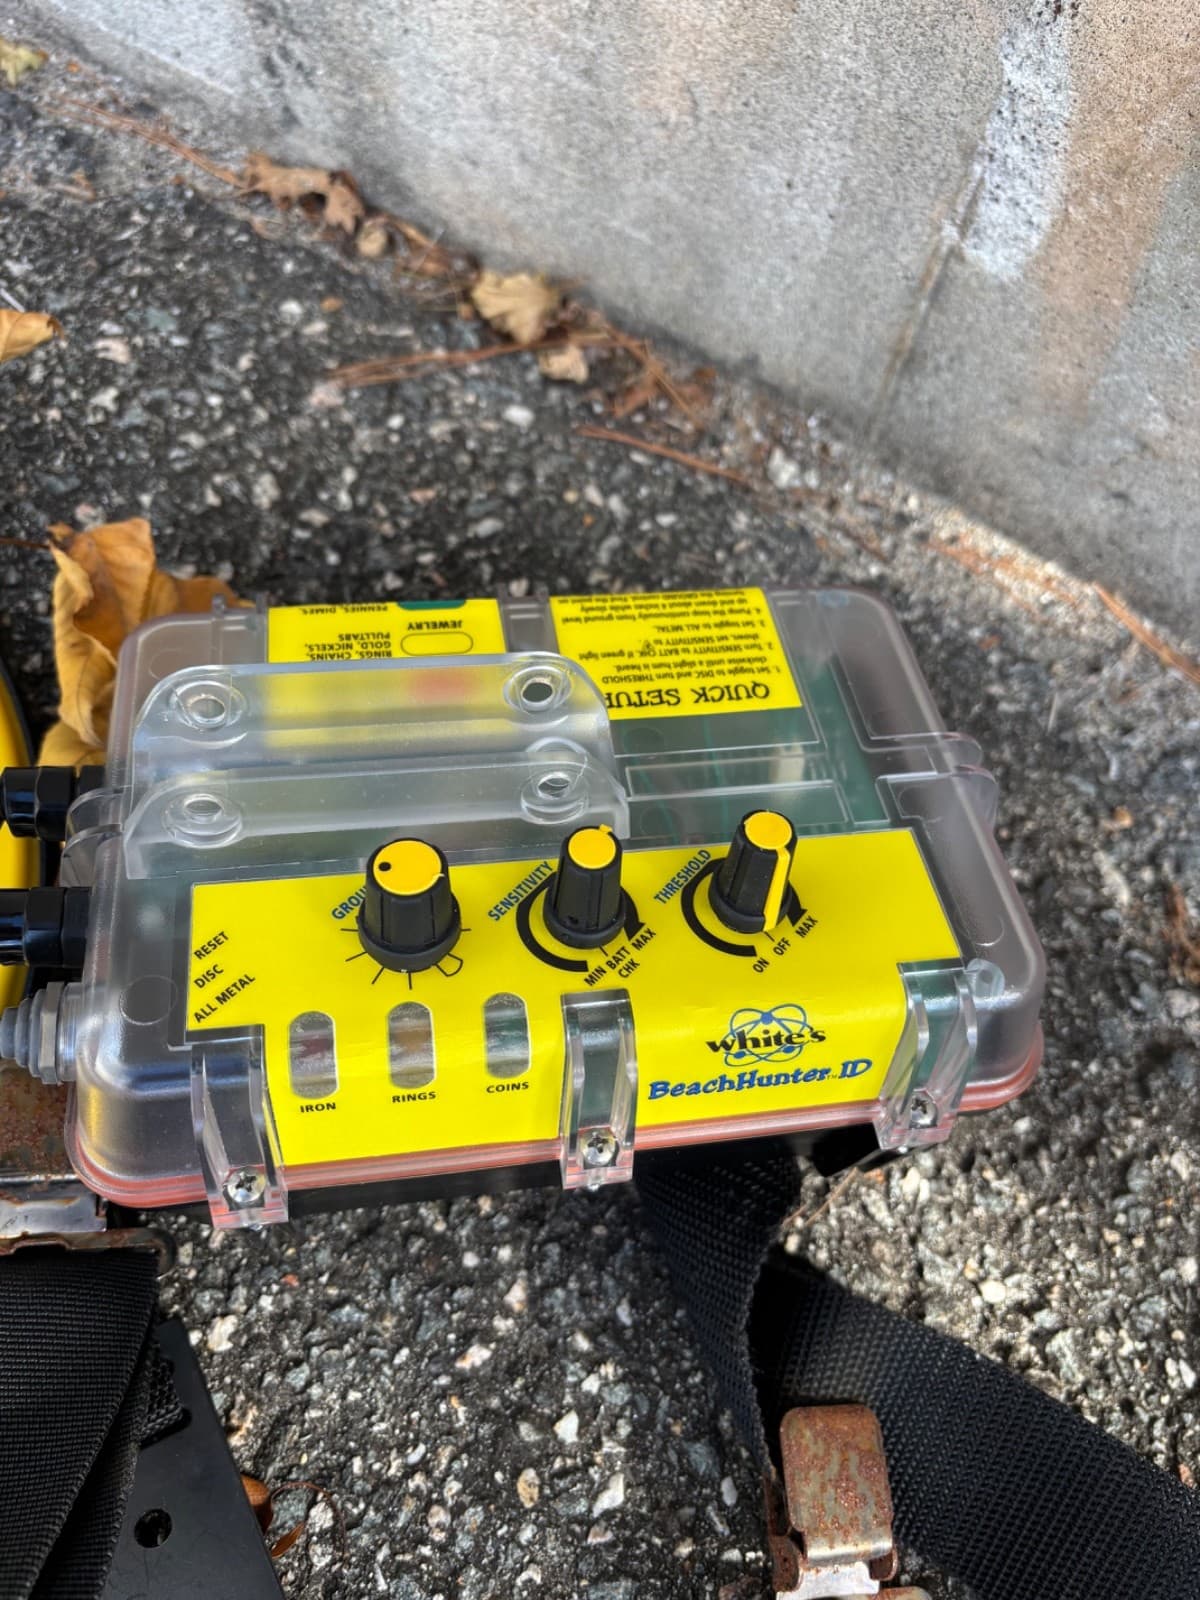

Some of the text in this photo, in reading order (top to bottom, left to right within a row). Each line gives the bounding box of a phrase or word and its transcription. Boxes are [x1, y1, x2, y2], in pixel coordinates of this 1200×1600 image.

[407, 620, 462, 631] JEWELRY
[684, 624, 700, 632] ALL
[714, 621, 740, 629] toggle
[338, 632, 390, 642] PULLTABS
[666, 636, 715, 646] SENSITIVITY
[304, 642, 353, 652] NICKELS,
[693, 645, 742, 654] SENSITIVITY
[744, 643, 763, 651] Turn
[306, 650, 393, 661] RINGS, CHAINS,
[579, 651, 599, 659] light
[600, 649, 625, 658] green
[673, 658, 696, 668] slight
[705, 658, 725, 667] until
[728, 656, 767, 664] clockwise
[613, 664, 641, 672] heard.
[652, 662, 671, 670] hum
[728, 666, 755, 676] toggle
[757, 666, 770, 674] Set
[656, 672, 674, 680] turn
[676, 671, 693, 679] and
[695, 670, 715, 678] DISC
[602, 674, 654, 685] THRESHOLD
[690, 681, 770, 704] QUICK
[654, 849, 712, 904] THRESHOLD
[488, 861, 553, 921] SENSITIVITY
[332, 886, 368, 920] GROU
[194, 930, 229, 960] RESET
[752, 915, 818, 974] ON OFF MAX
[584, 928, 656, 986] MIN BATT MAX
[618, 958, 640, 979] CHK
[194, 964, 224, 989] DISC
[194, 973, 256, 1023] ALL METAL
[648, 1068, 832, 1100] BeachHunter
[838, 1058, 872, 1080] ID
[486, 1082, 529, 1094] COINS
[392, 1092, 436, 1104] RINGS
[300, 1102, 336, 1114] IRON
